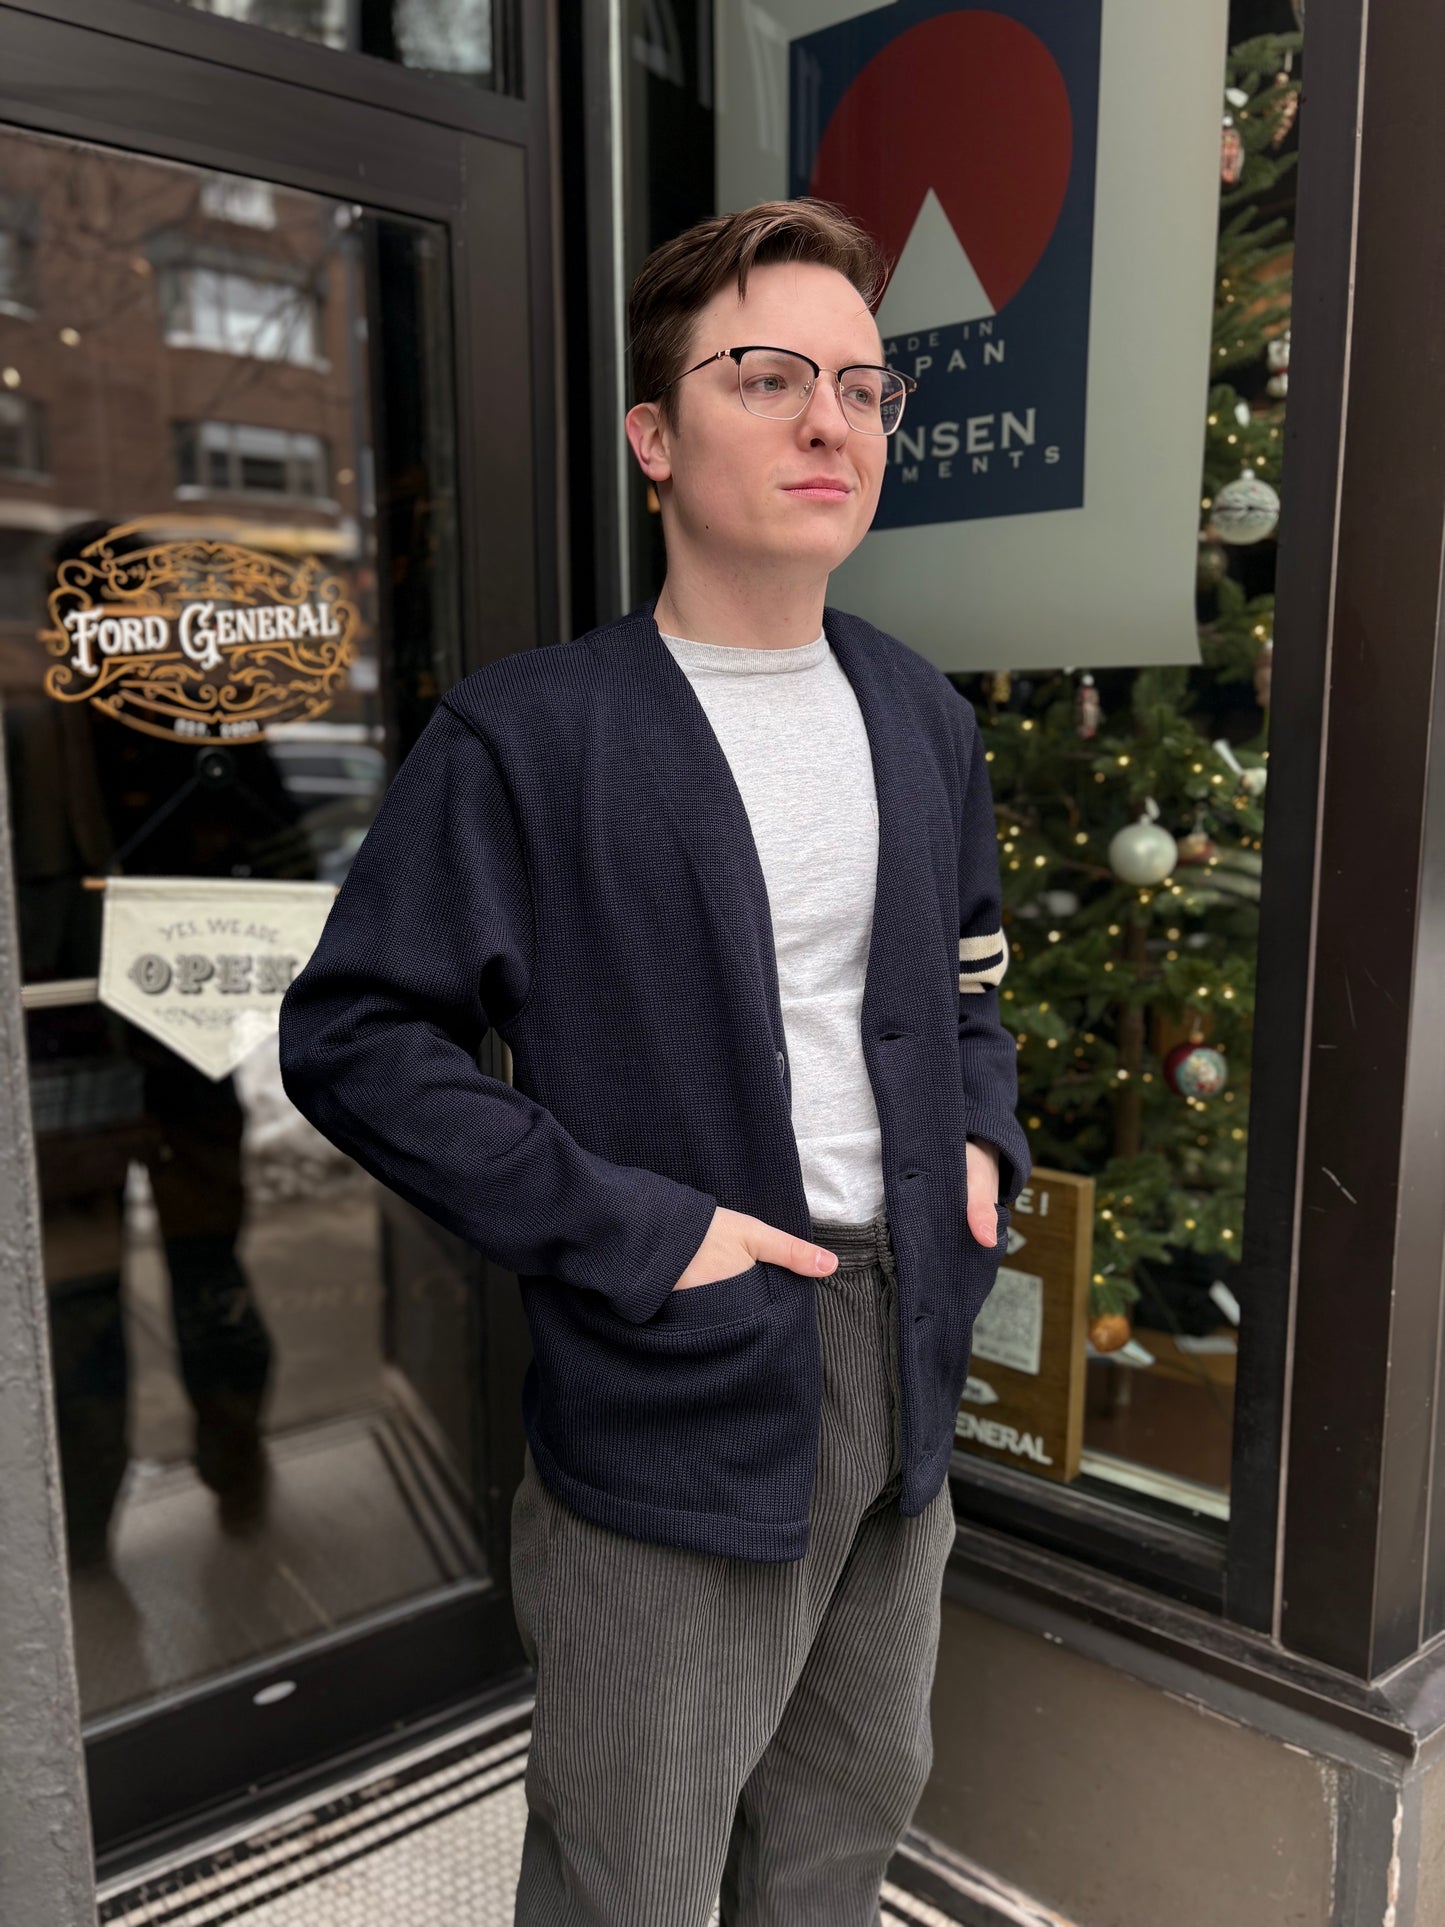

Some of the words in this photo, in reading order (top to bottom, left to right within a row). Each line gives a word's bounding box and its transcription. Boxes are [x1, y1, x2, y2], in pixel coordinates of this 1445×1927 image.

[885, 332, 940, 356] ADE
[963, 320, 993, 340] IN
[888, 340, 1005, 378] PAN
[892, 408, 1037, 464] NSEN
[902, 446, 1061, 484] MENTS
[63, 607, 171, 676] FORD
[178, 601, 340, 671] GENERAL
[128, 953, 299, 996] OPEN
[954, 1411, 1054, 1466] ENERAL
